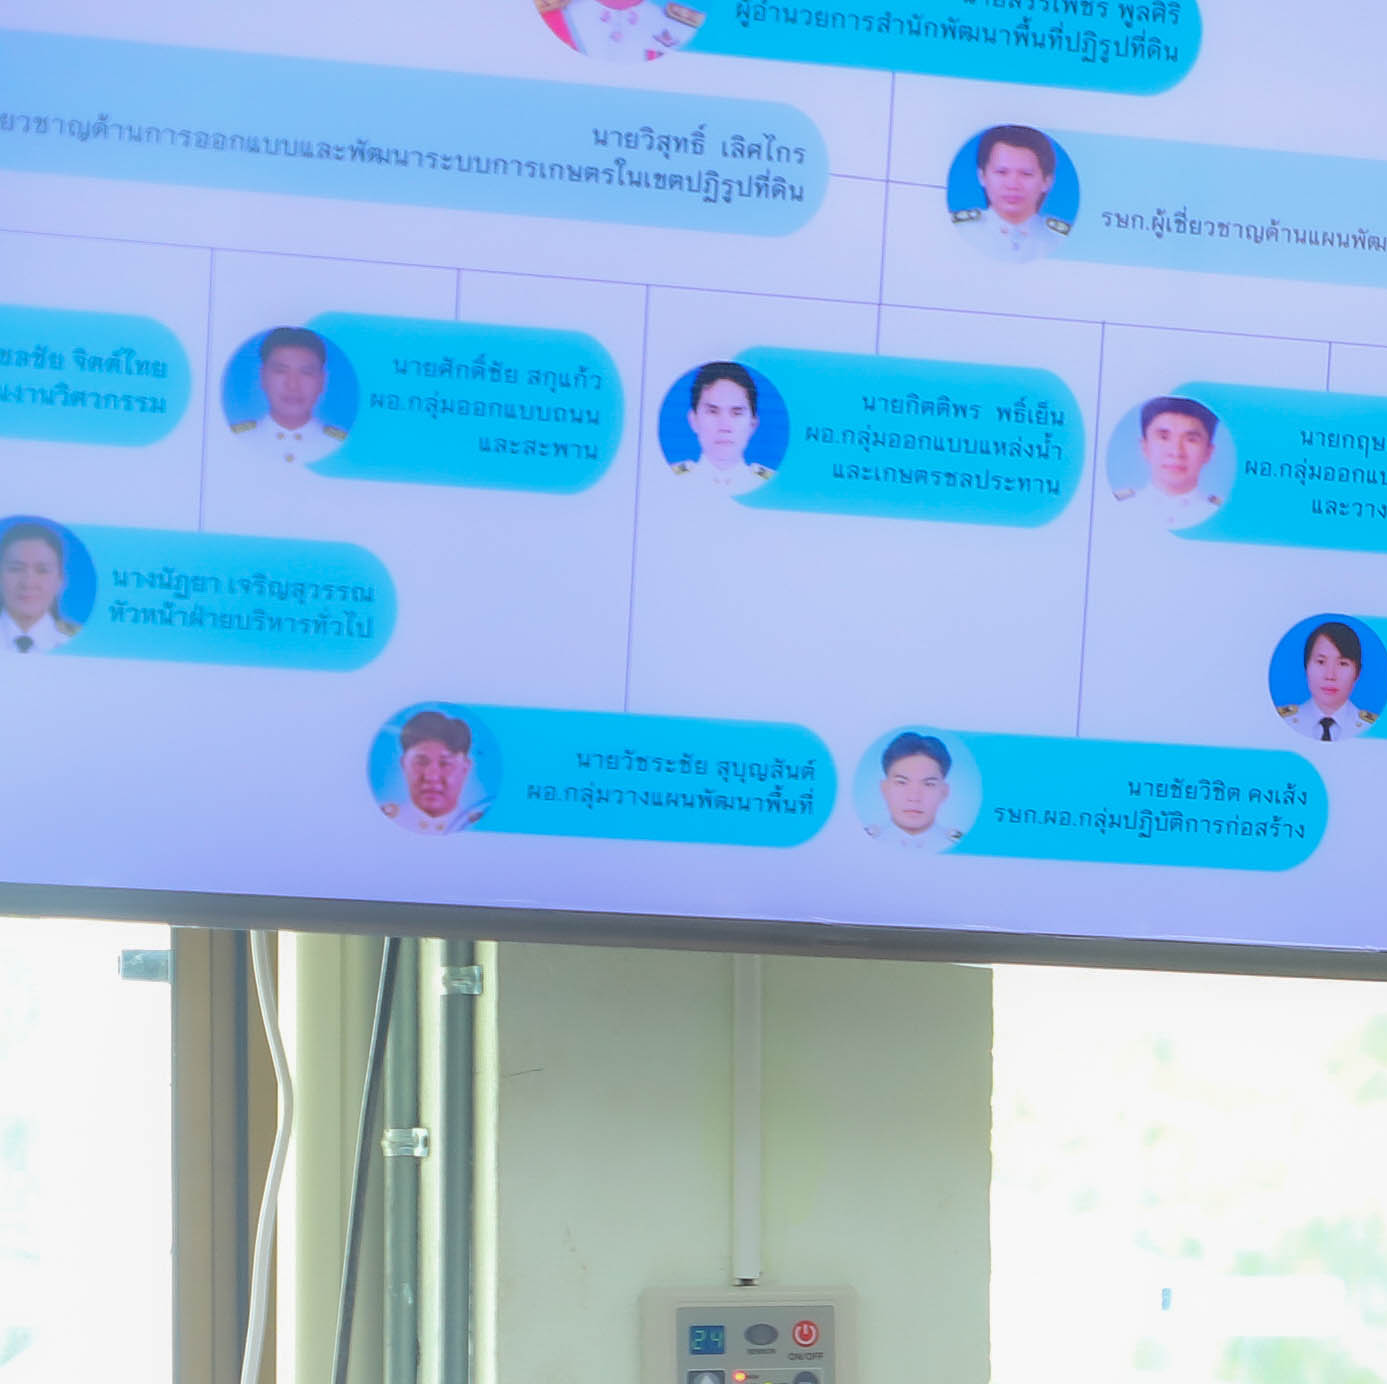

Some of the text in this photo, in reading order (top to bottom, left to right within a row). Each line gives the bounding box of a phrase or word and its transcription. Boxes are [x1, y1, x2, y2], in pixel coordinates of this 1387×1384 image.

[722, 133, 806, 166] เลิศไกร
[478, 436, 599, 461] และสะพาน
[831, 462, 1061, 496] และเกษตรชลประทาน
